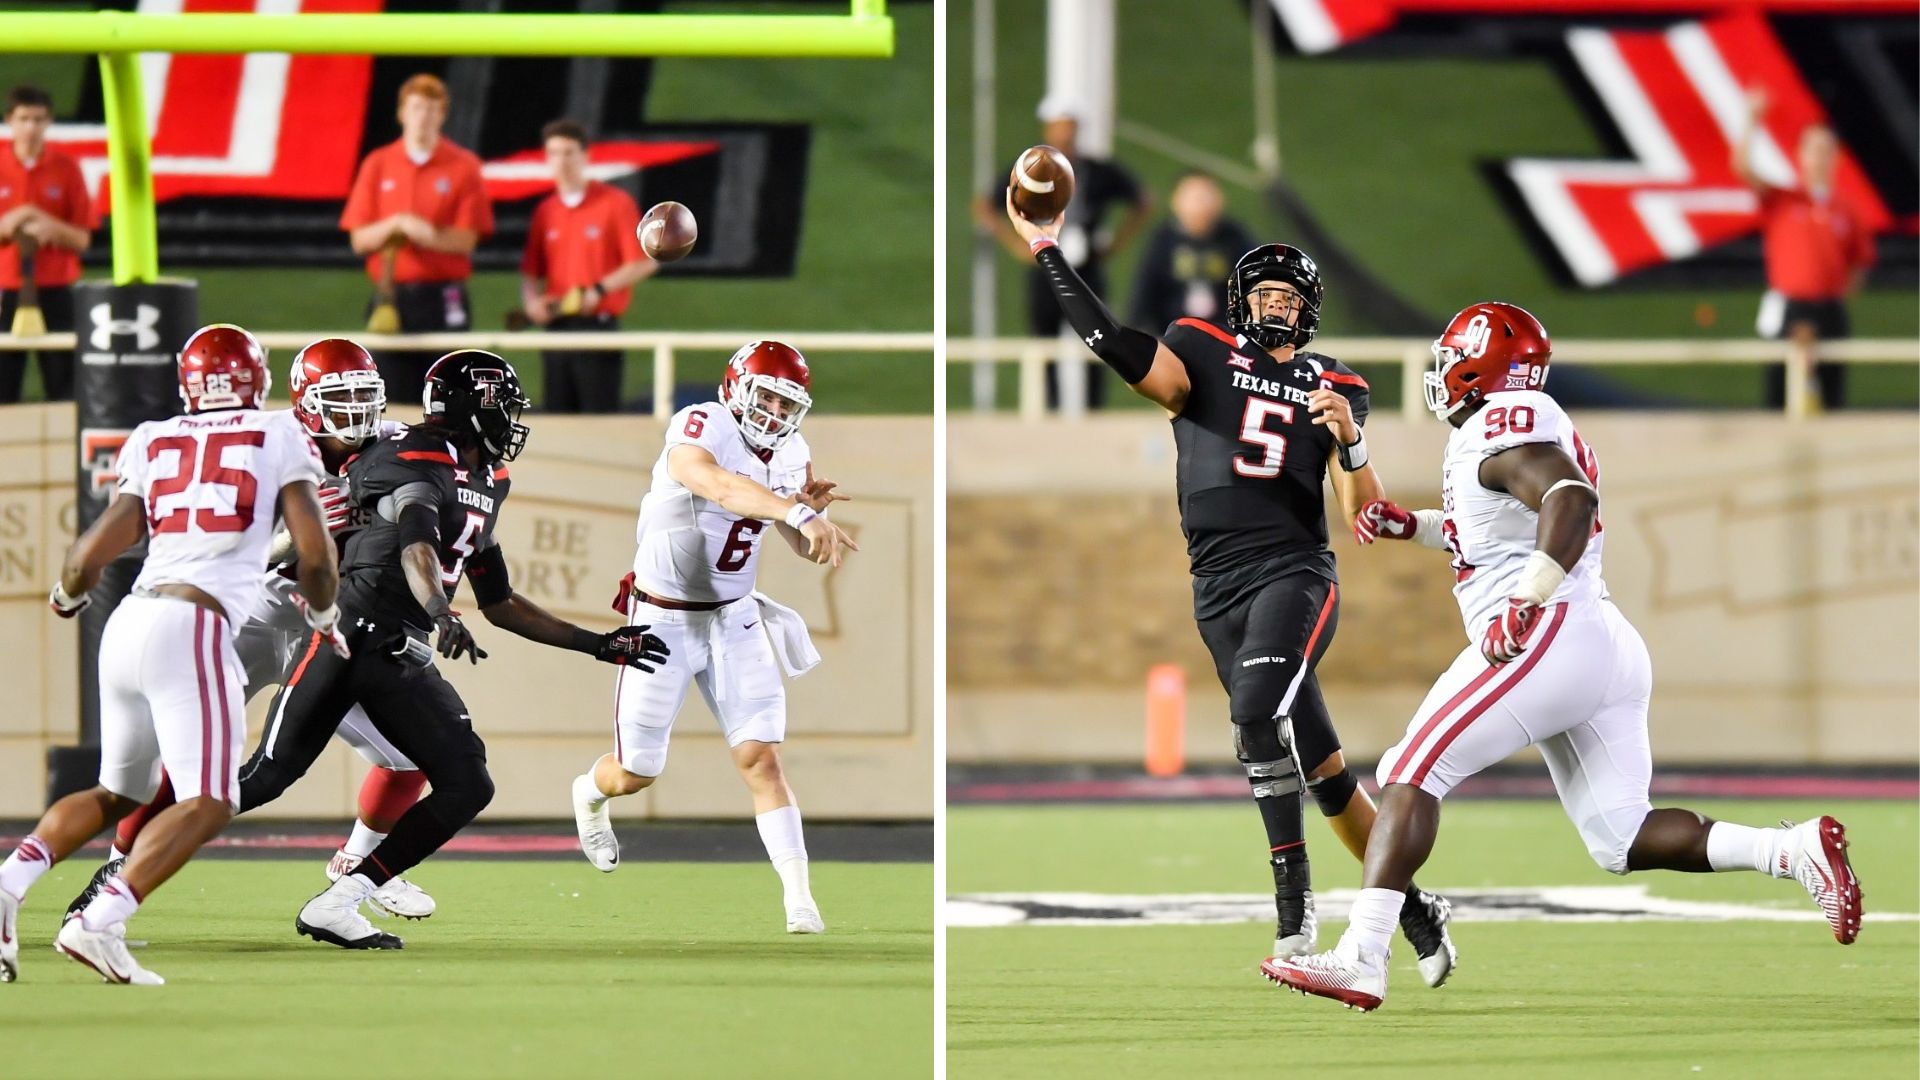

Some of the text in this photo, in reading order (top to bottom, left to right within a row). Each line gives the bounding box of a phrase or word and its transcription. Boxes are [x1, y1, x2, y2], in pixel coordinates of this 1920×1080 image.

[206, 373, 233, 395] 25
[1232, 371, 1309, 406] TEXAS TEC
[683, 410, 708, 440] 6
[1232, 396, 1295, 479] 5
[1485, 405, 1534, 440] 90
[147, 430, 266, 535] 25
[457, 487, 494, 514] TEXAS TECH
[441, 511, 486, 584] 5
[531, 516, 592, 557] BE
[716, 518, 762, 572] 6
